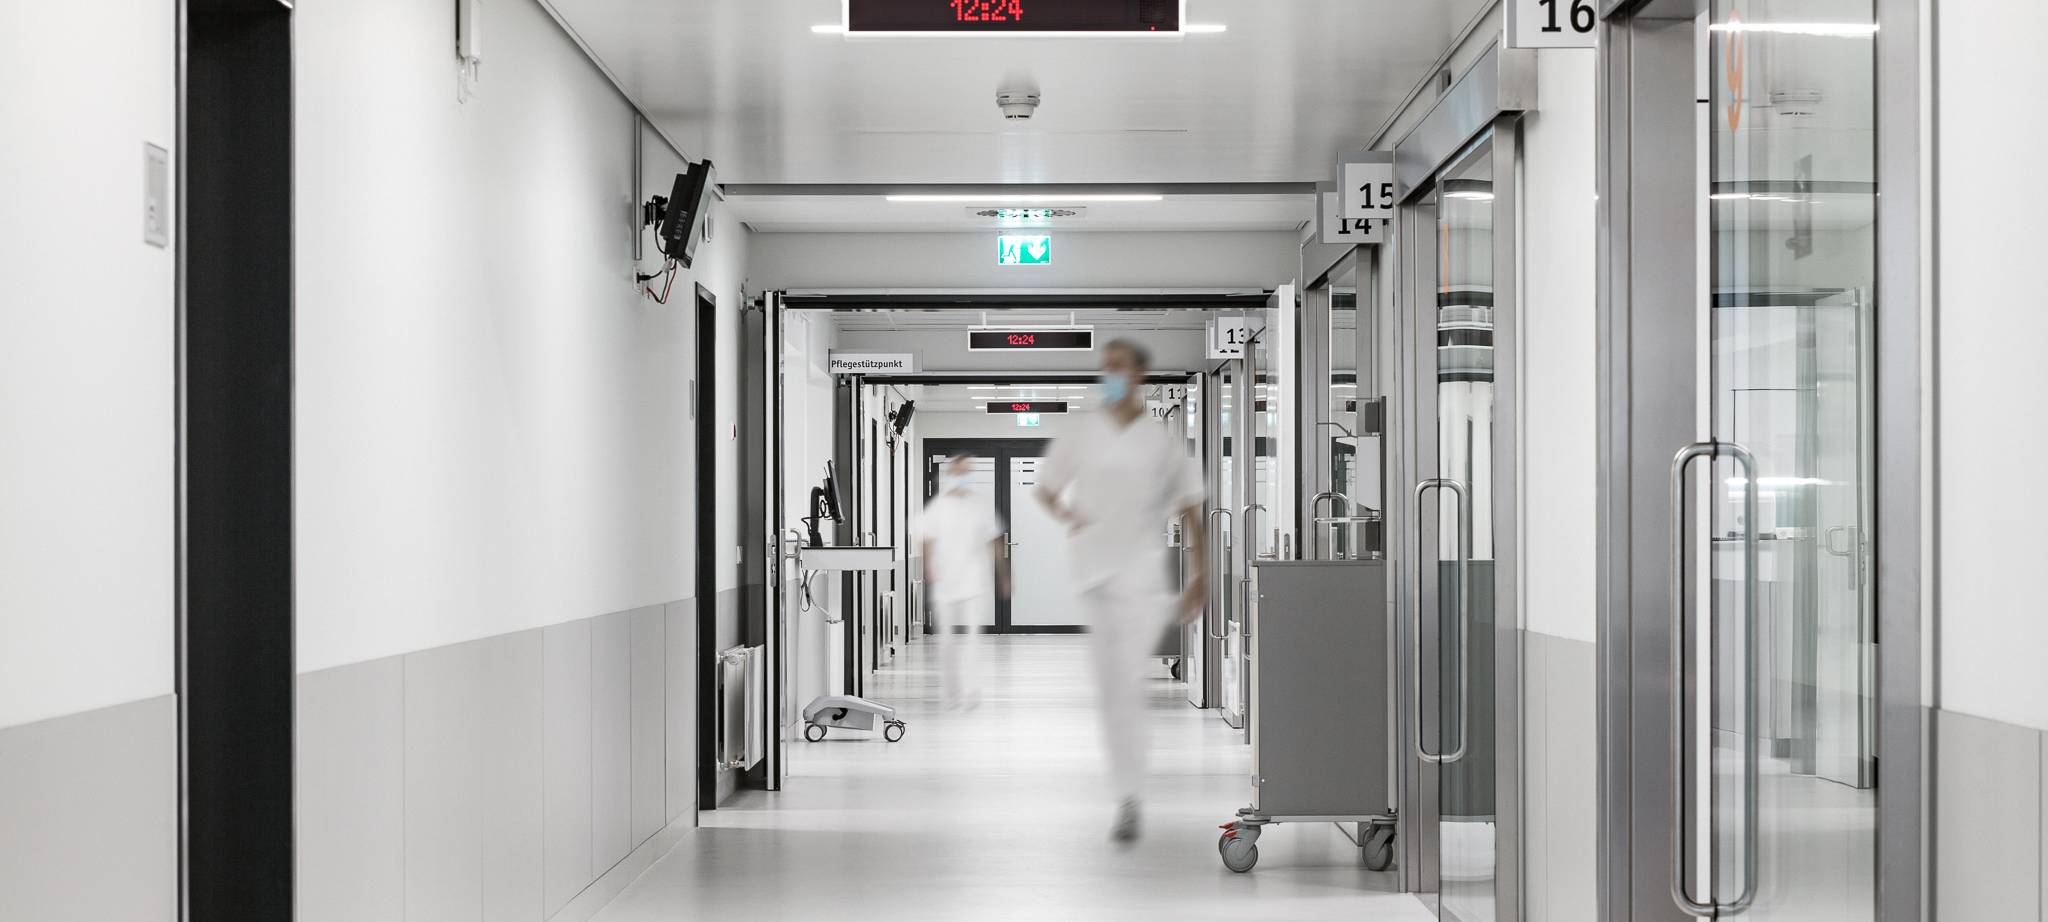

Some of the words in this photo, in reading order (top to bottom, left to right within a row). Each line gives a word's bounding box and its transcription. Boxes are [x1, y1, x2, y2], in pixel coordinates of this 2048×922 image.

[950, 0, 1023, 21] 12:24
[1538, 0, 1595, 33] 16
[1360, 182, 1393, 209] 15
[1007, 334, 1035, 345] 12:24
[831, 360, 903, 369] Pflegestützpunkt
